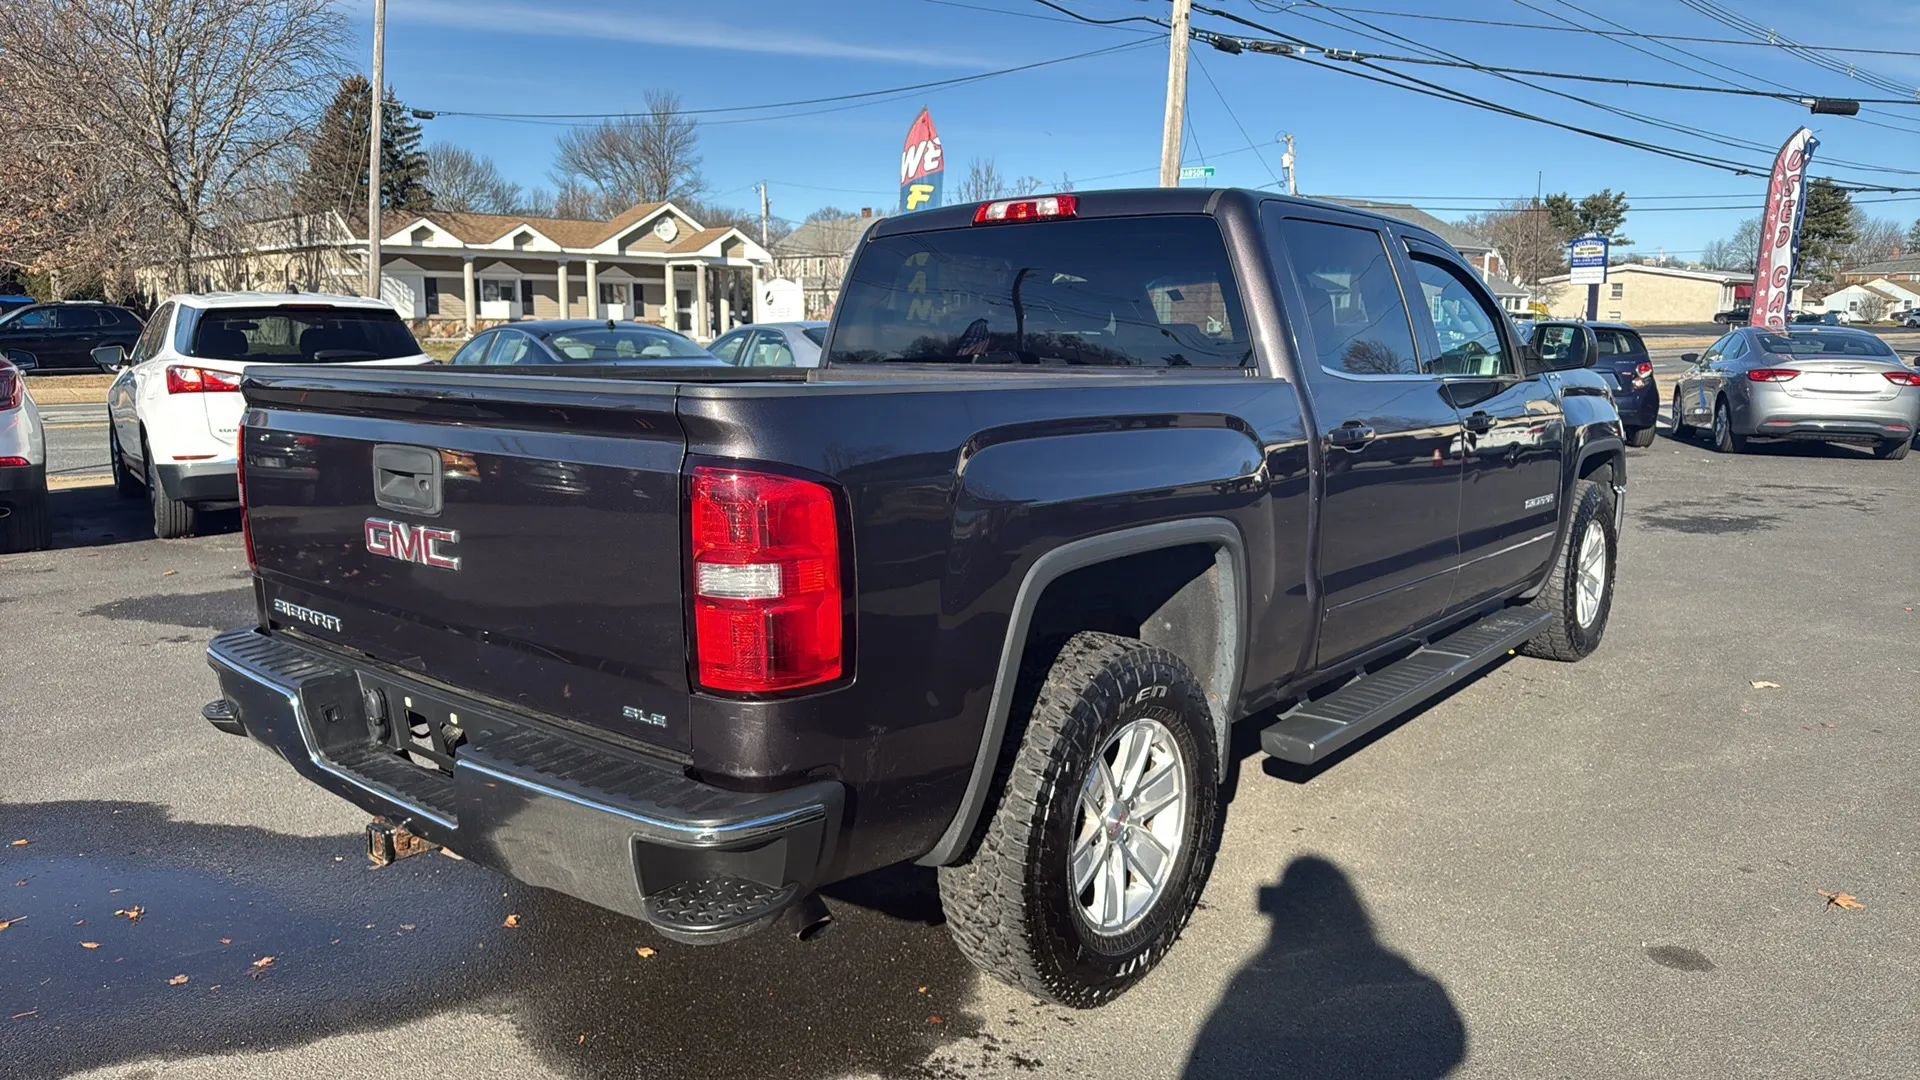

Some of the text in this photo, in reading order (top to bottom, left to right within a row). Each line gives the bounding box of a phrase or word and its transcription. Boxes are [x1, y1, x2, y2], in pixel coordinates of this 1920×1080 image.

[901, 137, 942, 183] WE
[1775, 149, 1805, 249] USED
[364, 516, 462, 571] GMC
[274, 598, 342, 633] SIERRA
[622, 705, 668, 729] SLE
